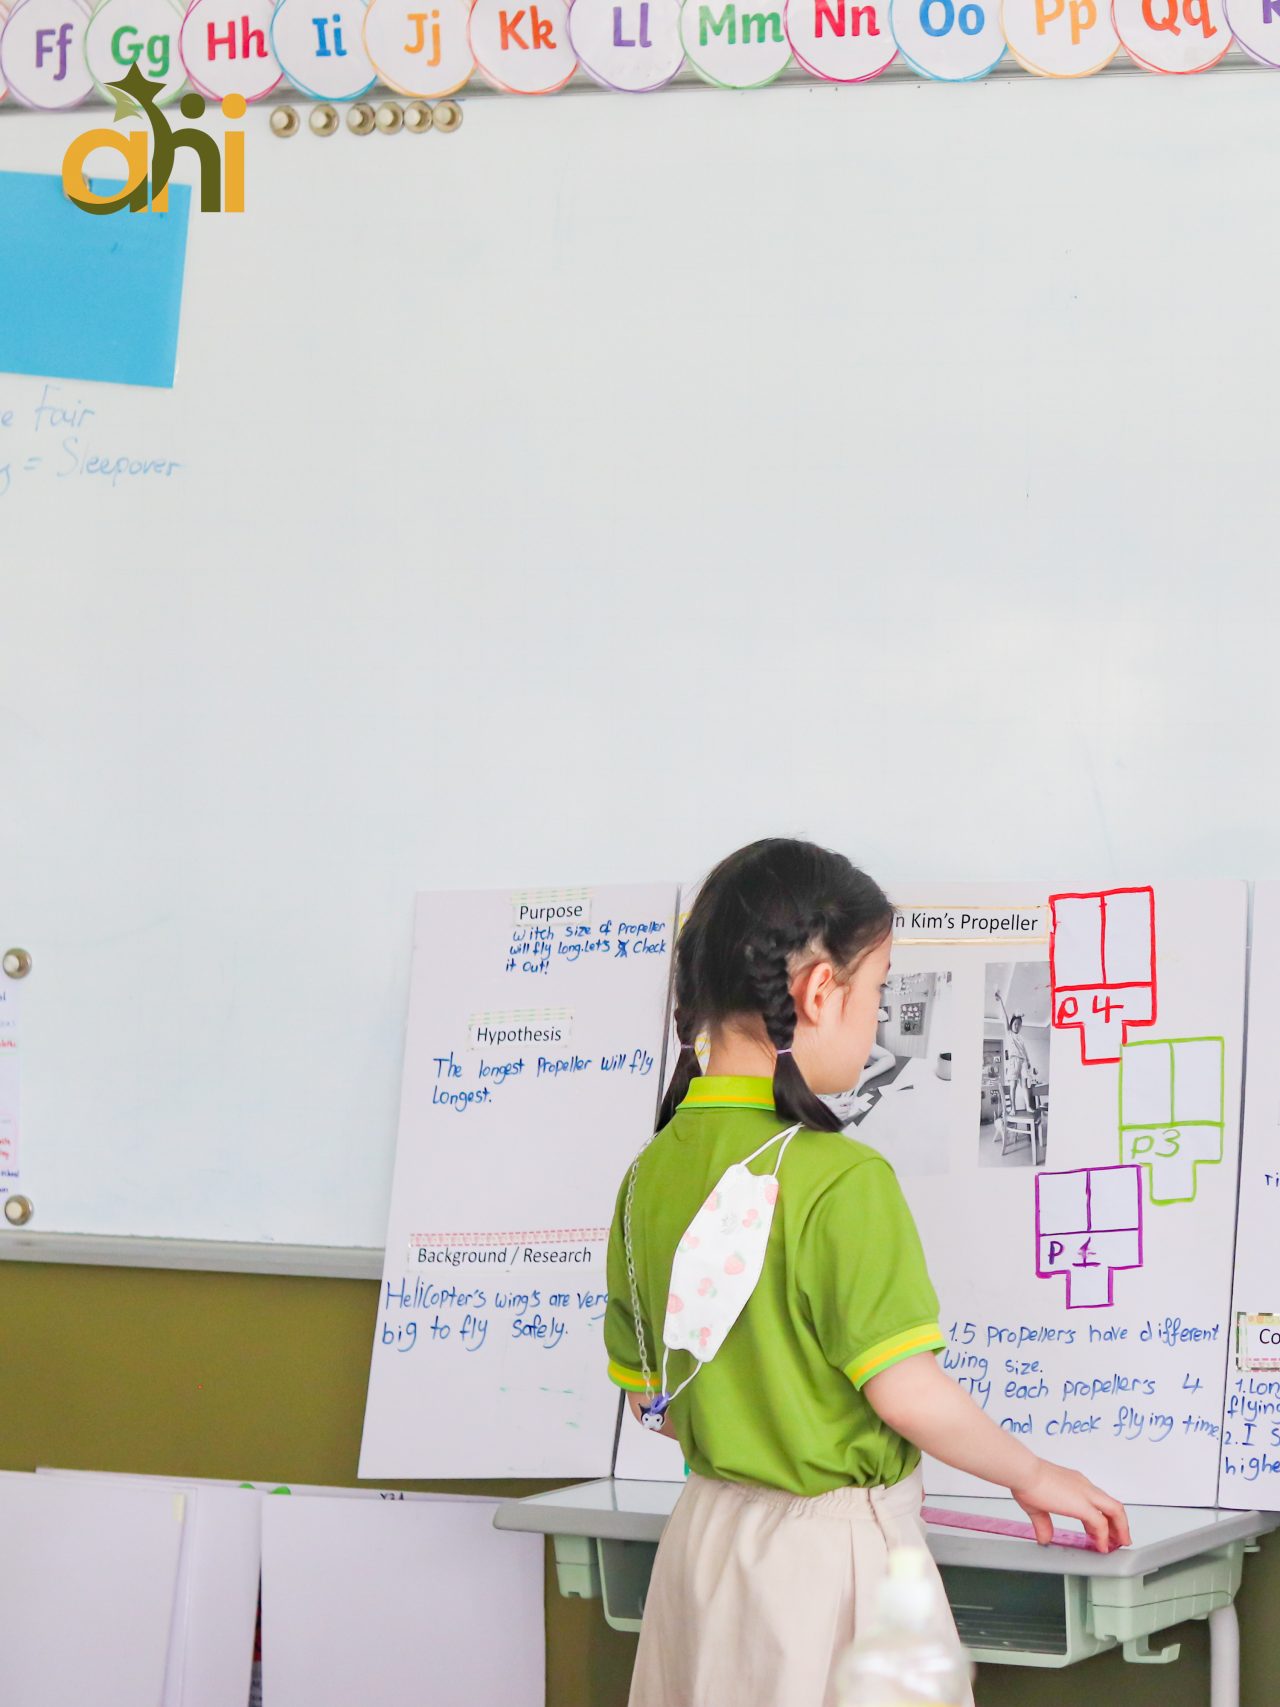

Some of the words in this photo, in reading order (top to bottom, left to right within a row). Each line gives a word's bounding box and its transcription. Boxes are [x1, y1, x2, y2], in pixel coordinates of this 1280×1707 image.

[312, 14, 347, 57] Ii
[499, 3, 557, 50] Kk
[612, 2, 653, 48] Ll
[701, 3, 784, 47] Mm
[814, 0, 880, 38] Nn
[918, 0, 985, 37] Oo
[1034, 0, 1098, 45] Pp
[1141, 0, 1218, 38] Qq
[35, 23, 74, 81] Ff
[110, 25, 171, 78] Gg
[207, 16, 268, 61] Hh
[403, 9, 441, 67] Jj
[57, 436, 182, 488] Sleepover
[519, 905, 583, 922] Purpose
[911, 912, 955, 929] Kim's
[961, 914, 1039, 933] Propeller
[477, 1026, 562, 1044] Hypothesis
[433, 1052, 463, 1078] The
[478, 1058, 525, 1084] longest
[417, 1247, 507, 1266] Background
[523, 1247, 592, 1264] Research
[382, 1320, 417, 1352] big
[430, 1315, 451, 1340] to
[459, 1314, 489, 1352] fly
[1089, 1323, 1128, 1343] have
[1139, 1317, 1219, 1347] different
[1005, 1378, 1048, 1400] each
[1182, 1372, 1204, 1394] 4
[1046, 1410, 1101, 1435] check
